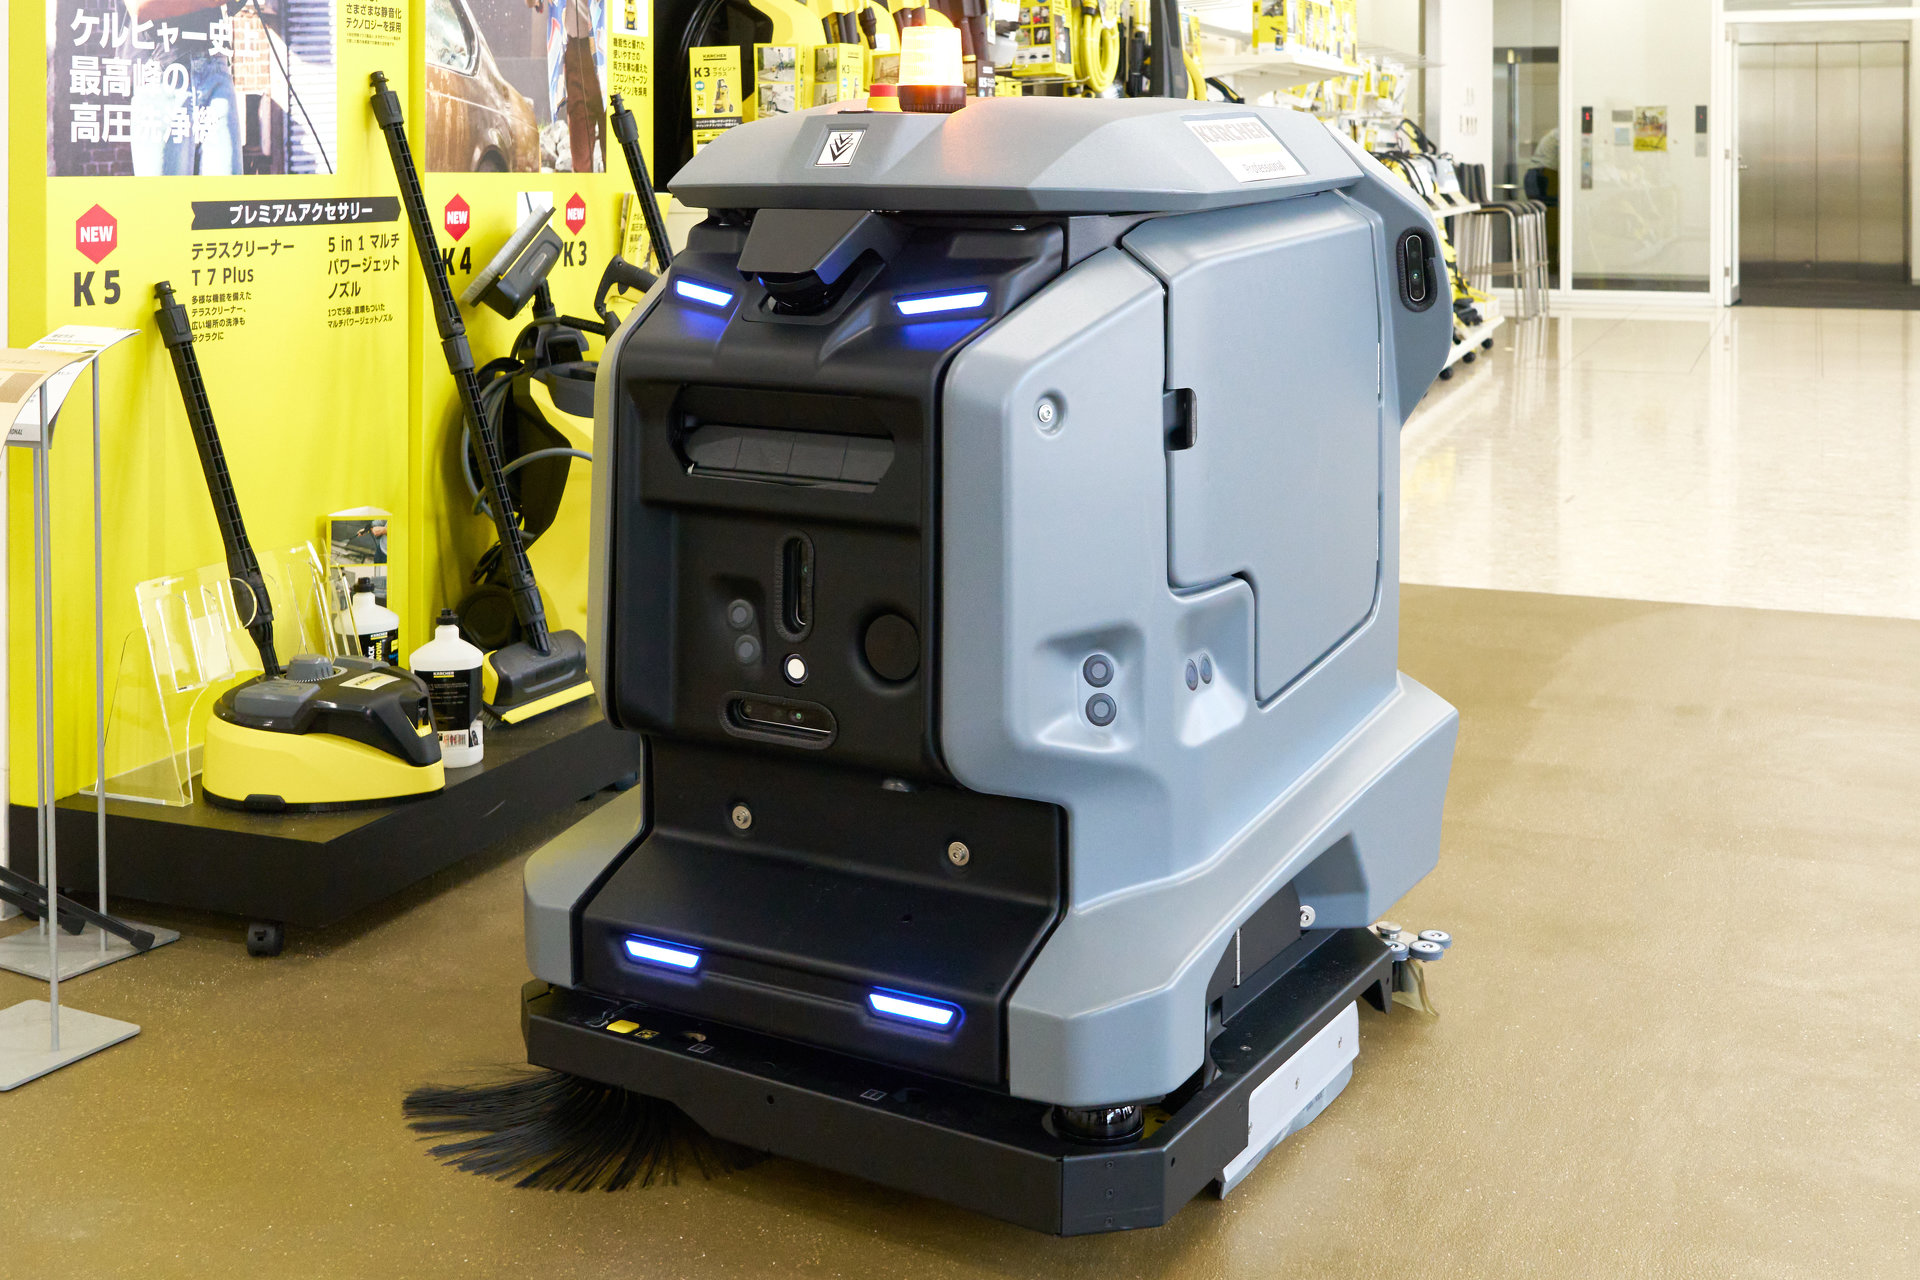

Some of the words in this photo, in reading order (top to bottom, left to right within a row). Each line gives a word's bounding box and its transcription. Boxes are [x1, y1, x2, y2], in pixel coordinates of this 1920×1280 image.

[346, 17, 402, 33] テクノロジーを採用
[69, 55, 189, 97] 最高峰の
[230, 201, 374, 225] プレミアムアクセサリー
[447, 210, 468, 225] NEW
[567, 207, 585, 220] NEW
[81, 225, 113, 243] NEW
[328, 237, 335, 253] 5
[341, 235, 353, 251] in
[359, 235, 365, 250] 1
[370, 232, 400, 249] マルチ
[192, 239, 295, 260] テラスクリーナー
[328, 255, 400, 275] パワージェット
[192, 269, 201, 286] T
[208, 268, 217, 286] 7
[223, 266, 254, 285] Plus
[192, 291, 252, 305] 多様な機能を備えた
[328, 281, 361, 299] ノズル
[192, 317, 246, 331] 広い場所の洗浄も
[328, 313, 393, 328] マルチパワージェットノズル
[192, 331, 224, 343] ラクラクに
